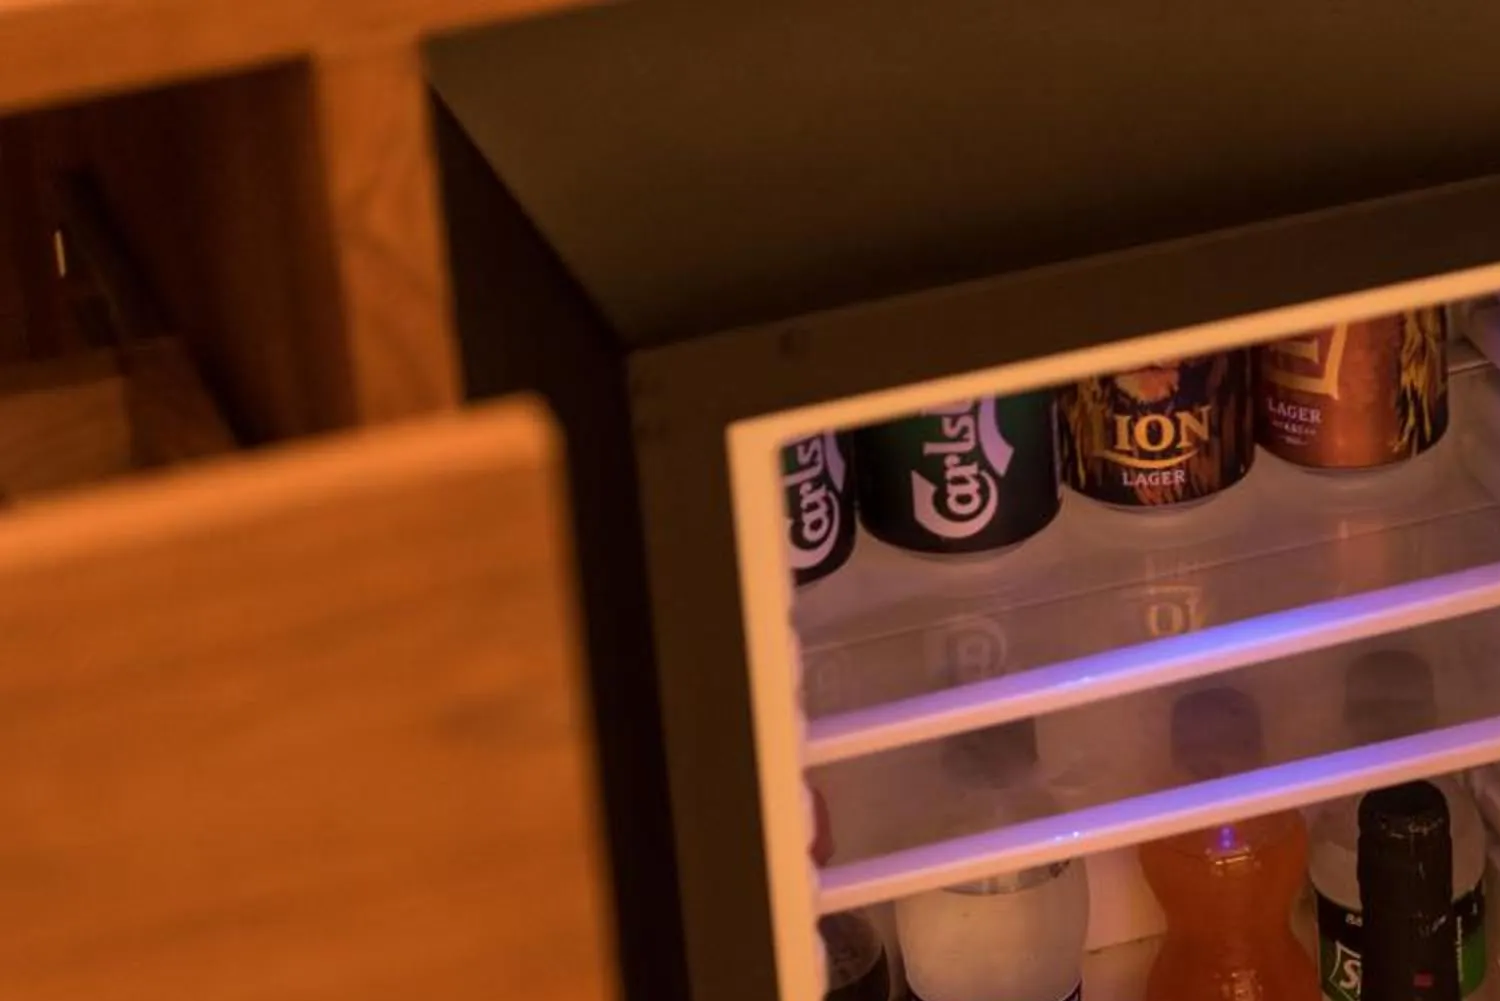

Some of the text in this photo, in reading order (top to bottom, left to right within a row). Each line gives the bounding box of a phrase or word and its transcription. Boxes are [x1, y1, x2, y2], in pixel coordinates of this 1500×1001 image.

[1267, 397, 1322, 425] LAGER
[786, 435, 841, 570] Carls
[911, 398, 1000, 539] Carls
[1122, 469, 1186, 487] LAGER
